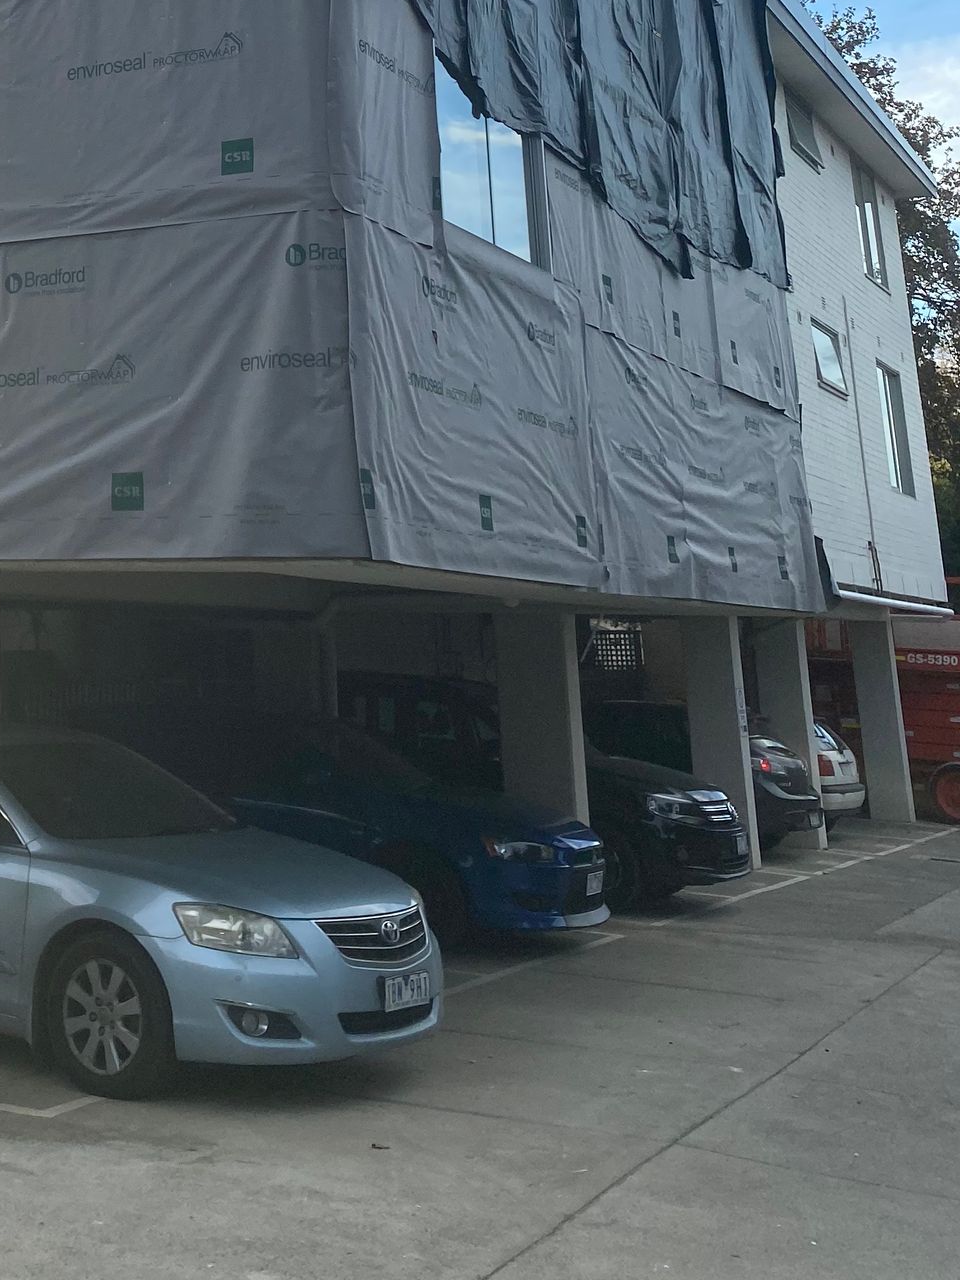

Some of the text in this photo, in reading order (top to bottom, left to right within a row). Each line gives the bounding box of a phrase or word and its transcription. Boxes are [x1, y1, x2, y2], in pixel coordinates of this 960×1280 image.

[67, 52, 147, 81] enviroseal
[224, 150, 250, 163] CSR
[25, 266, 85, 288] Bradford
[240, 347, 331, 372] enviroseal
[907, 653, 958, 666] GS-5390
